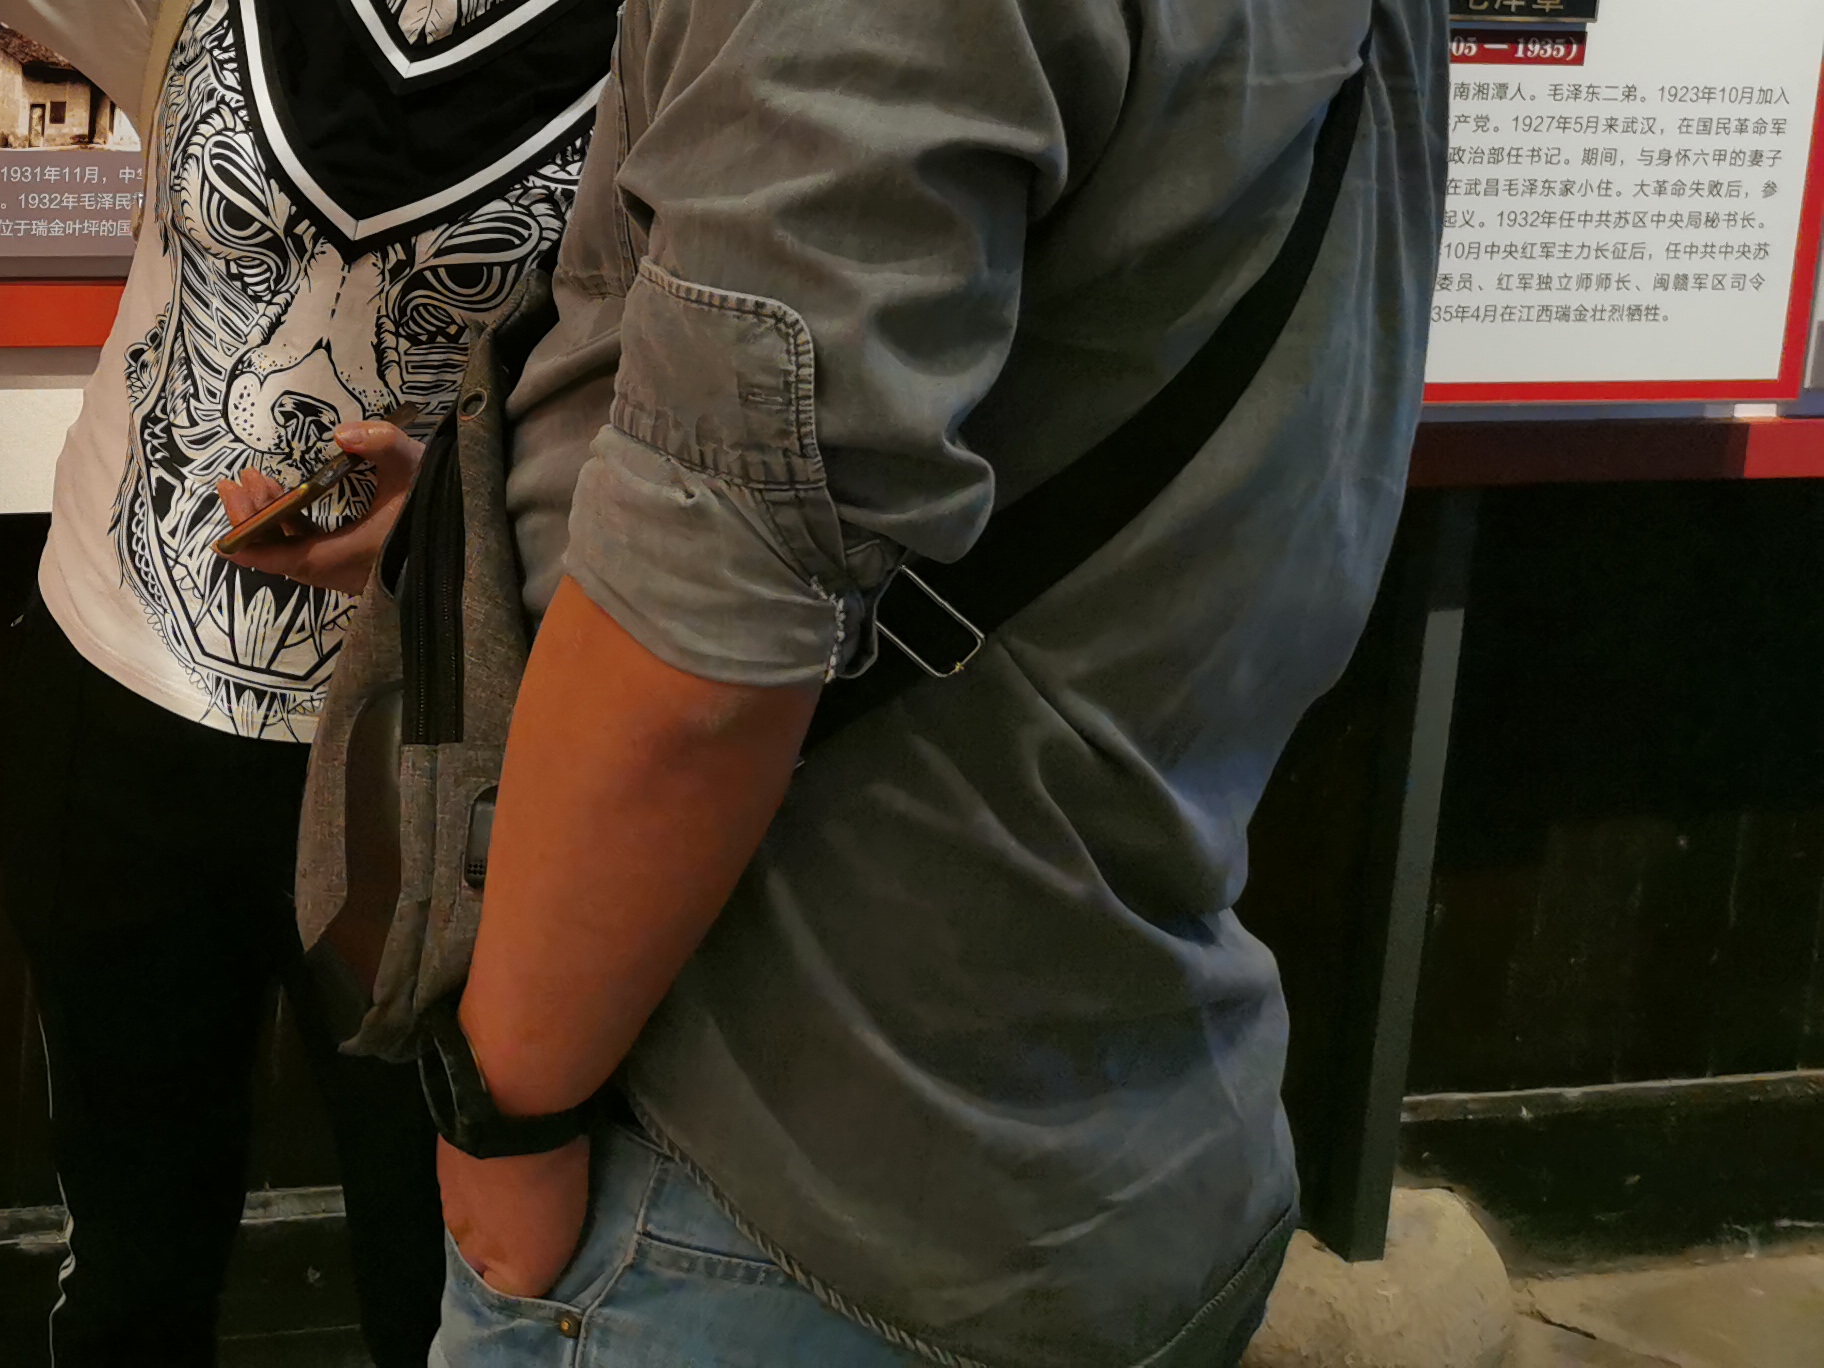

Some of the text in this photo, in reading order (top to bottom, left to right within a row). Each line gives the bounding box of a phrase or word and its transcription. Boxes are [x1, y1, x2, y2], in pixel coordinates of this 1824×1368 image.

[1450, 35, 1478, 57] 05
[1448, 113, 1788, 137] 产党。1927年5月来武汉，在国民革命军
[1447, 145, 1783, 168] 政治部任书记。期间，与身怀六甲的妻子
[1445, 177, 1778, 199] 在武昌毛泽东家小住。大革命失败后，参
[1439, 240, 1771, 261] 10月中央红军主力长征后，任中共中央苏
